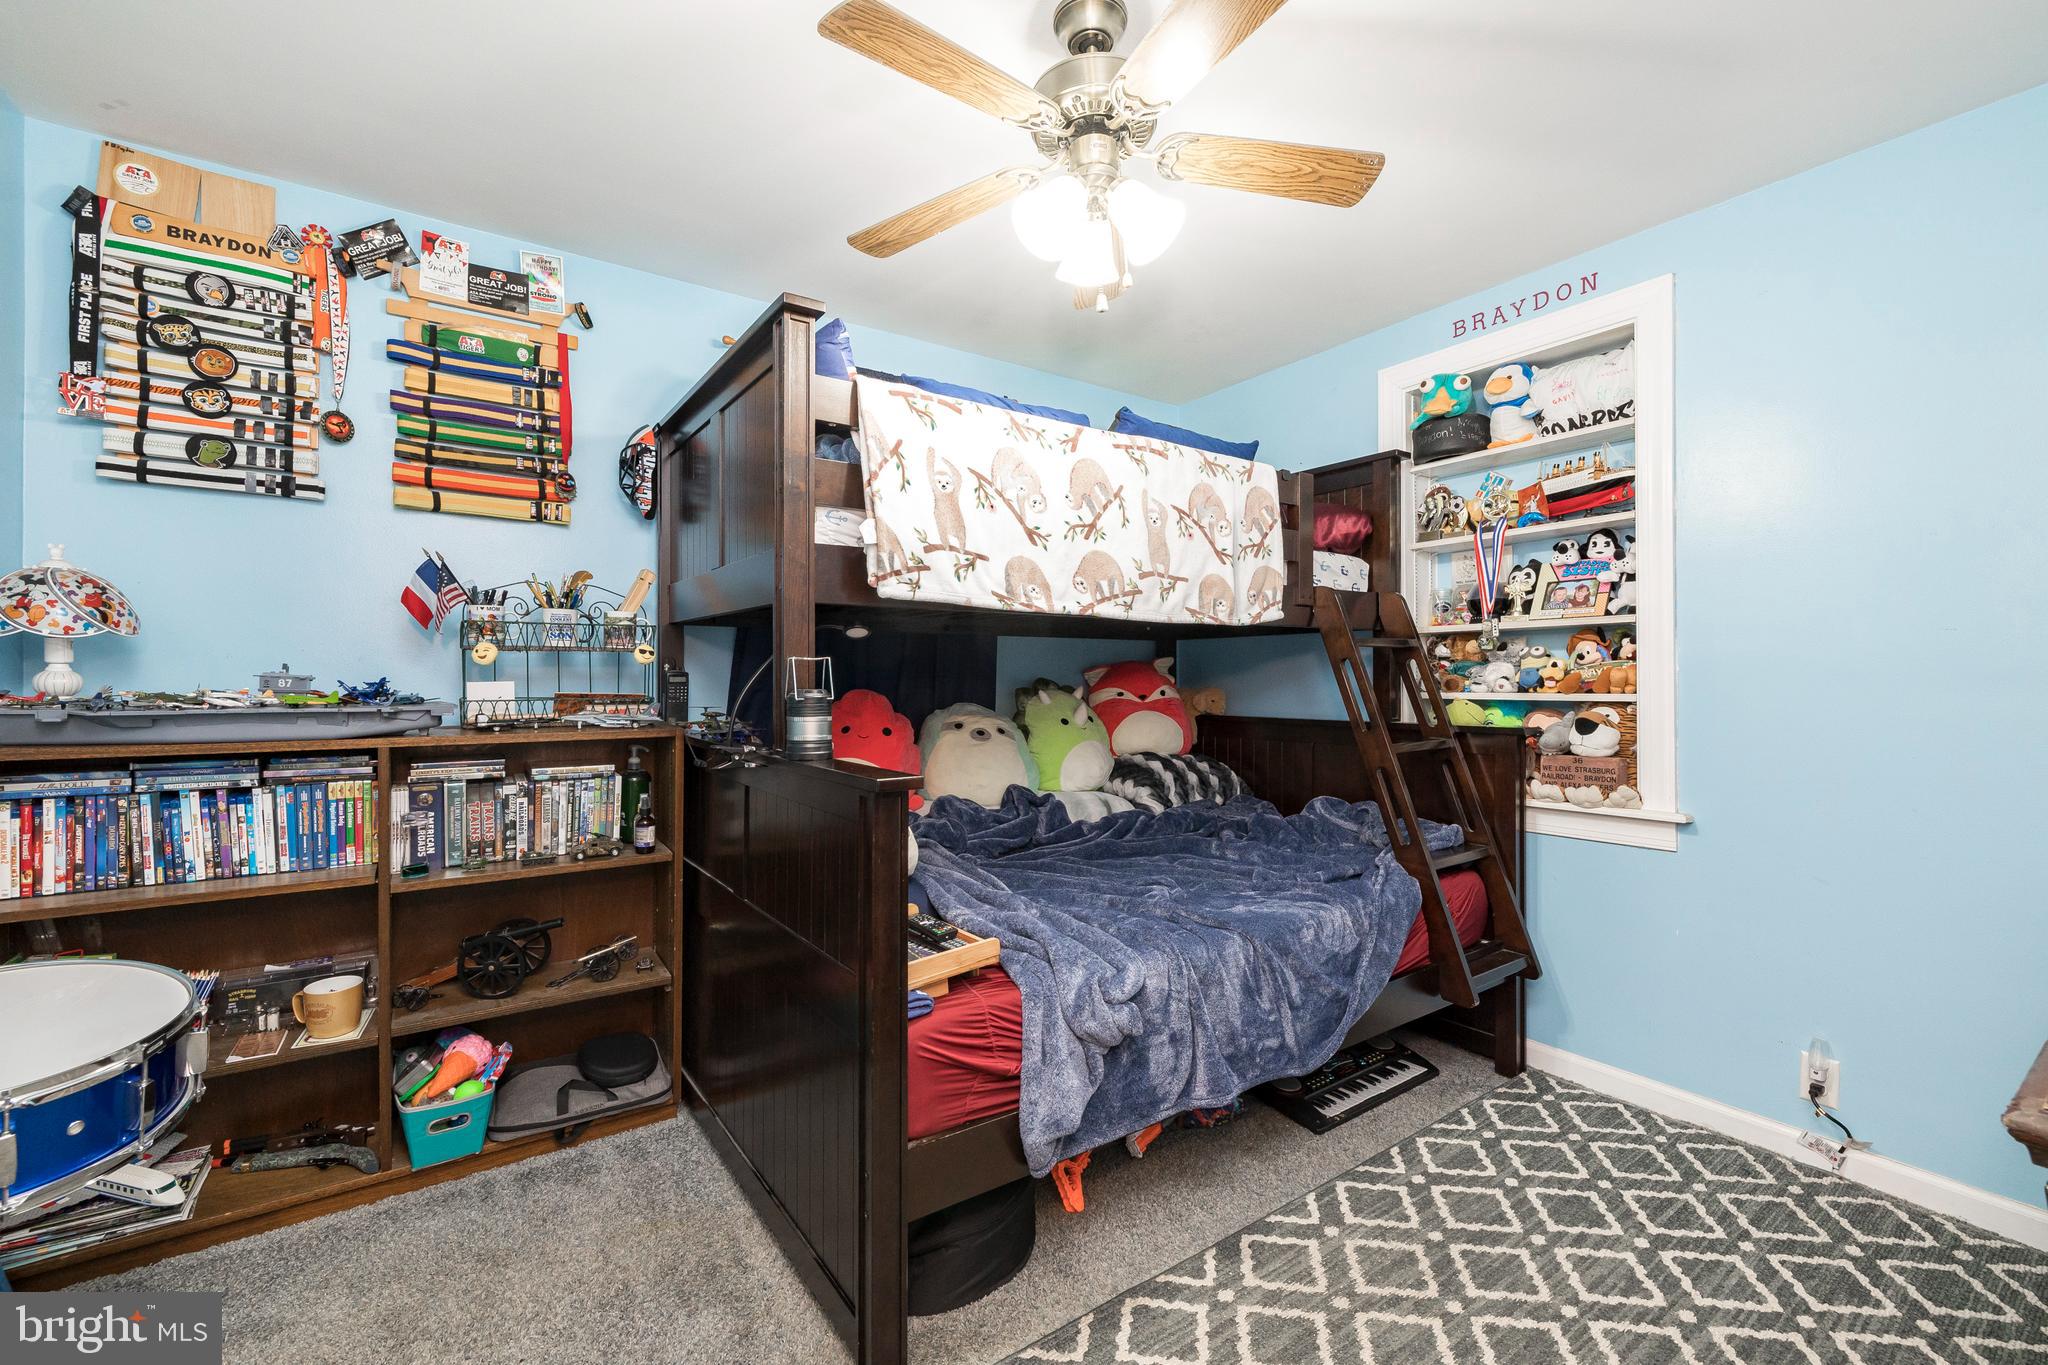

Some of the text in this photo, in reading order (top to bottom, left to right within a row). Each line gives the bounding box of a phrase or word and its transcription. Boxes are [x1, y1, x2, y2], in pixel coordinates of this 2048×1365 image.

[166, 224, 272, 260] BRAYDON
[347, 239, 381, 257] GREAT
[381, 232, 404, 247] JOB!
[531, 257, 553, 267] HAPPY
[468, 275, 502, 289] GREAT
[504, 284, 527, 294] JOB!
[529, 291, 558, 300] STRONG
[1452, 271, 1599, 339] BRAYDON
[77, 310, 92, 344] FIRST
[459, 343, 485, 354] TIGERS
[278, 678, 293, 688] 87
[1542, 764, 1616, 775] WE LOVE STRASBURG
[59, 780, 94, 790] DOLLY!
[1584, 775, 1617, 784] BRAYDON
[328, 802, 336, 820] Physical
[467, 801, 481, 842] TRAINS
[482, 800, 495, 841] TRAINS
[426, 811, 435, 854] AMERICAN
